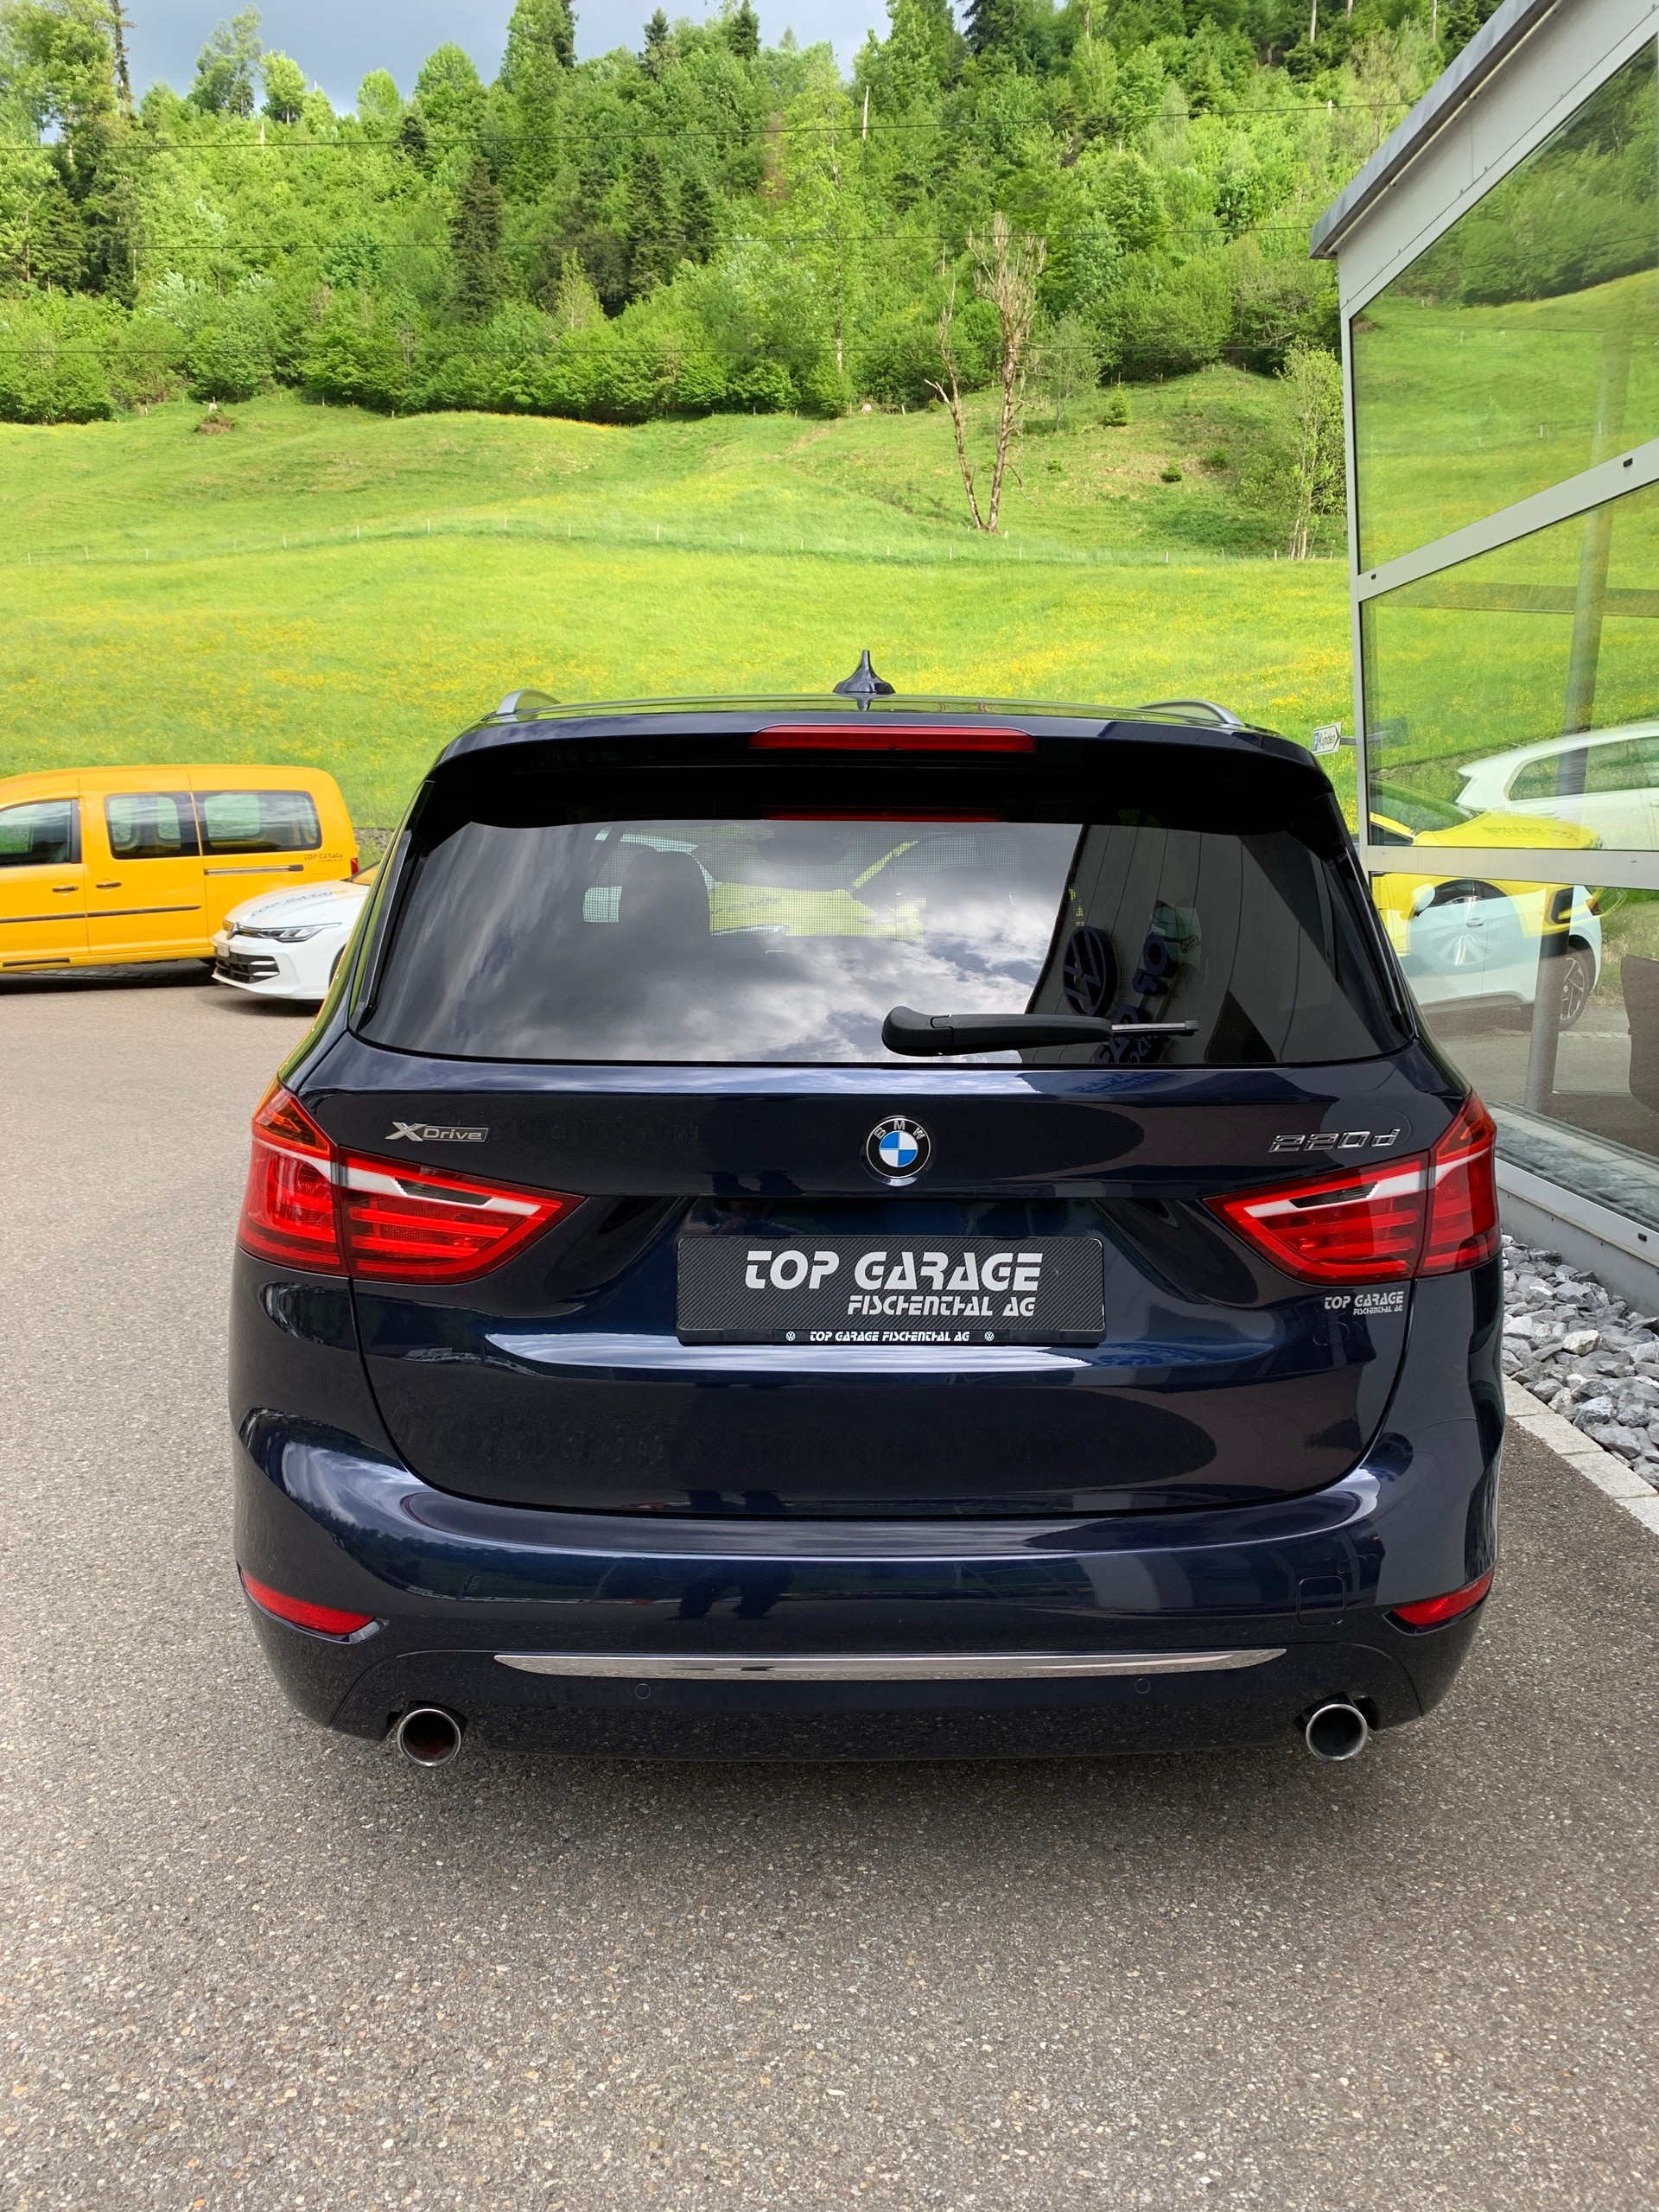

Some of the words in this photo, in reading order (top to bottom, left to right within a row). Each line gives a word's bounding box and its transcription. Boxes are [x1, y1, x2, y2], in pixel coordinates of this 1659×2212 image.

[874, 1120, 926, 1141] BMW
[1268, 1128, 1401, 1153] 220d
[745, 1249, 840, 1289] TOP
[854, 1251, 1043, 1292] GARAGE
[847, 1294, 993, 1316] FISCHENTHAL
[1002, 1296, 1036, 1317] AG
[1324, 1295, 1351, 1310] TOP
[1354, 1291, 1404, 1307] GARAGE
[1353, 1306, 1392, 1315] FISCHENTHAL
[810, 1331, 832, 1342] TOP
[835, 1331, 880, 1342] GARAGE
[882, 1331, 951, 1342] FISCHENTHAL
[954, 1331, 970, 1342] AG
